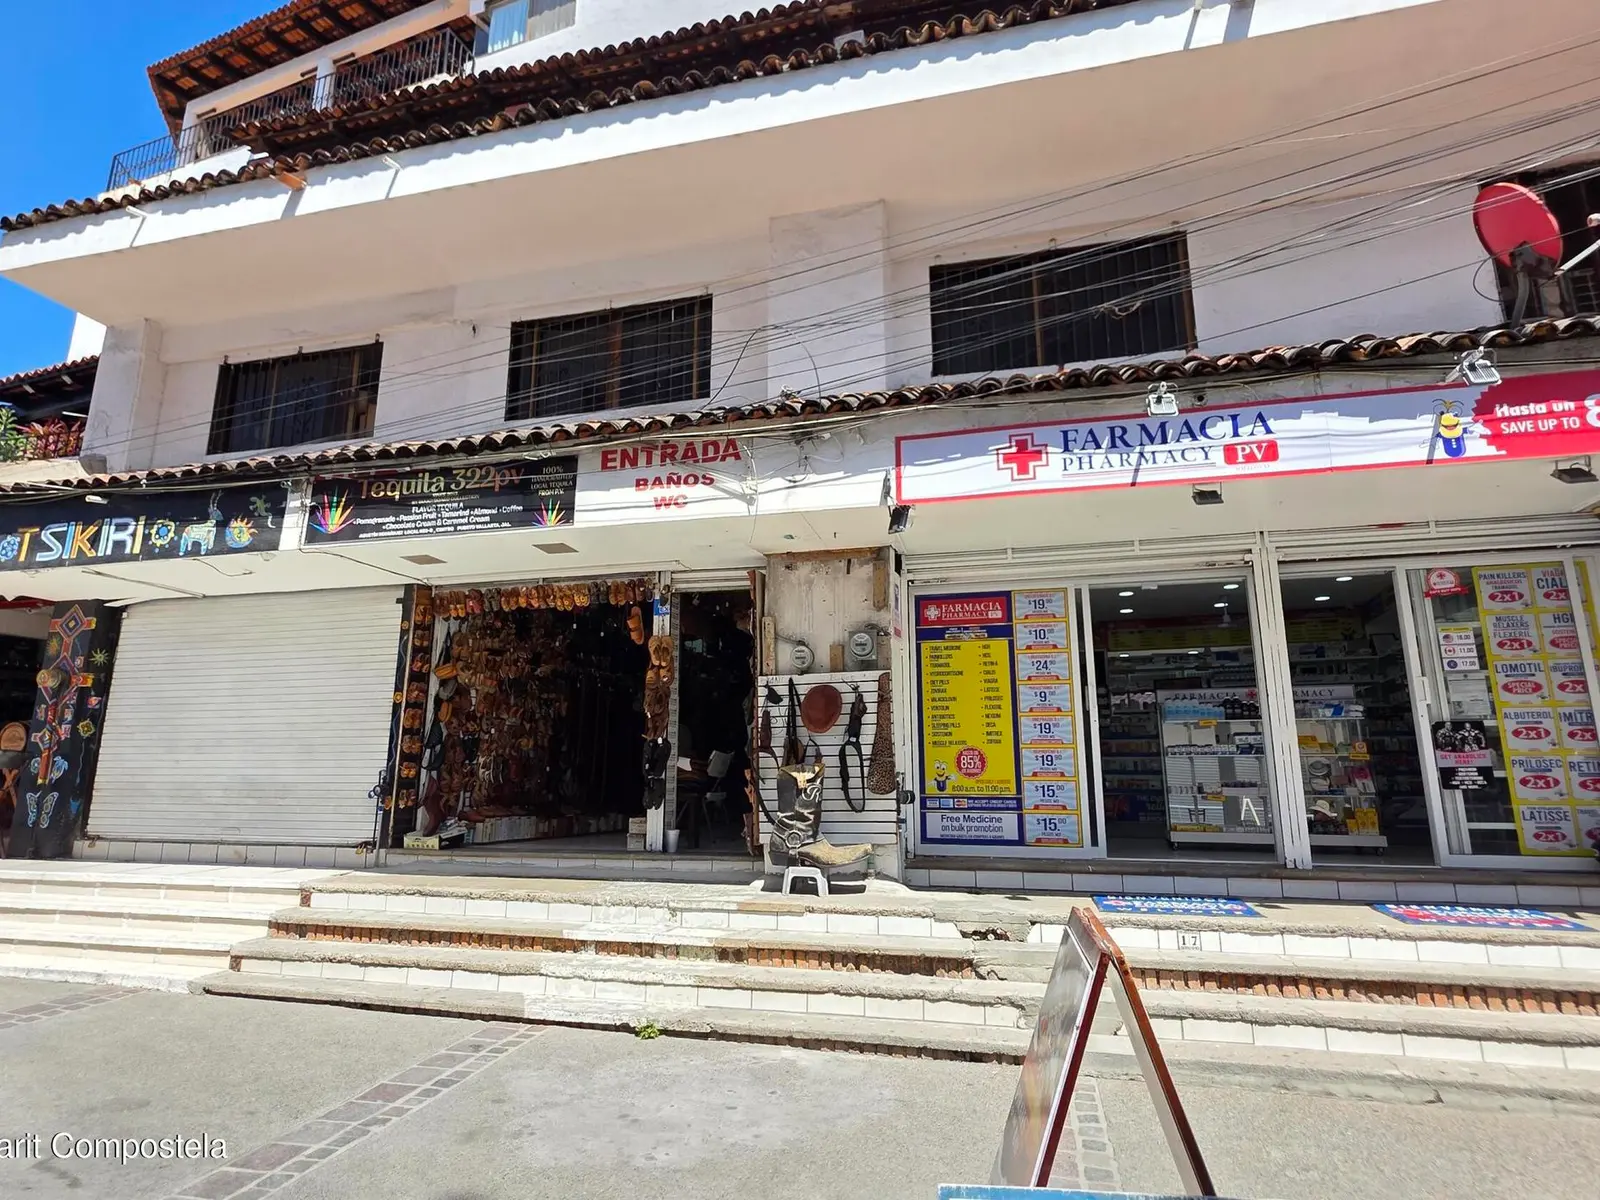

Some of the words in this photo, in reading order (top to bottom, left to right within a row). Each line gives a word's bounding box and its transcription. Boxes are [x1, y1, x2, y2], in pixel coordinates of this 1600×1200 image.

[1501, 420, 1535, 434] SAVE
[1538, 418, 1558, 431] UP
[1560, 416, 1580, 429] TO
[1060, 411, 1275, 453] FARMACIA
[601, 438, 741, 471] ENTRADA
[1062, 446, 1215, 470] PHARMACY
[1235, 443, 1268, 462] PV
[542, 466, 564, 474] 100%
[358, 472, 445, 500] Tequila
[635, 470, 715, 492] BAÑOS
[654, 493, 689, 510] WC
[412, 504, 436, 514] FLAVOR
[438, 502, 464, 512] TEQUILA
[423, 512, 436, 520] Fruit
[442, 509, 470, 518] Tamarind
[474, 506, 498, 515] Almond
[502, 504, 523, 513] Coffee
[386, 522, 416, 530] Chocolate
[1494, 592, 1519, 602] 2x1
[942, 602, 1002, 612] FARMACIA
[942, 611, 988, 619] PHARMACY
[1494, 630, 1532, 638] FLEXERIL
[1504, 640, 1529, 650] 2x1
[1495, 662, 1544, 674] LOMOTIL
[1504, 712, 1554, 720] ALBUTEROL
[1520, 728, 1546, 738] 2x1
[960, 755, 982, 768] 85%
[1512, 759, 1562, 768] PRILOSEC
[1527, 776, 1554, 788] 2x1
[941, 814, 961, 823] Free
[962, 814, 1002, 824] Medicine
[1522, 810, 1571, 822] LATISSE
[942, 824, 950, 832] on
[950, 823, 966, 832] bulk
[966, 824, 1004, 834] promotion
[1540, 832, 1563, 840] 2x1
[1182, 936, 1198, 946] 17
